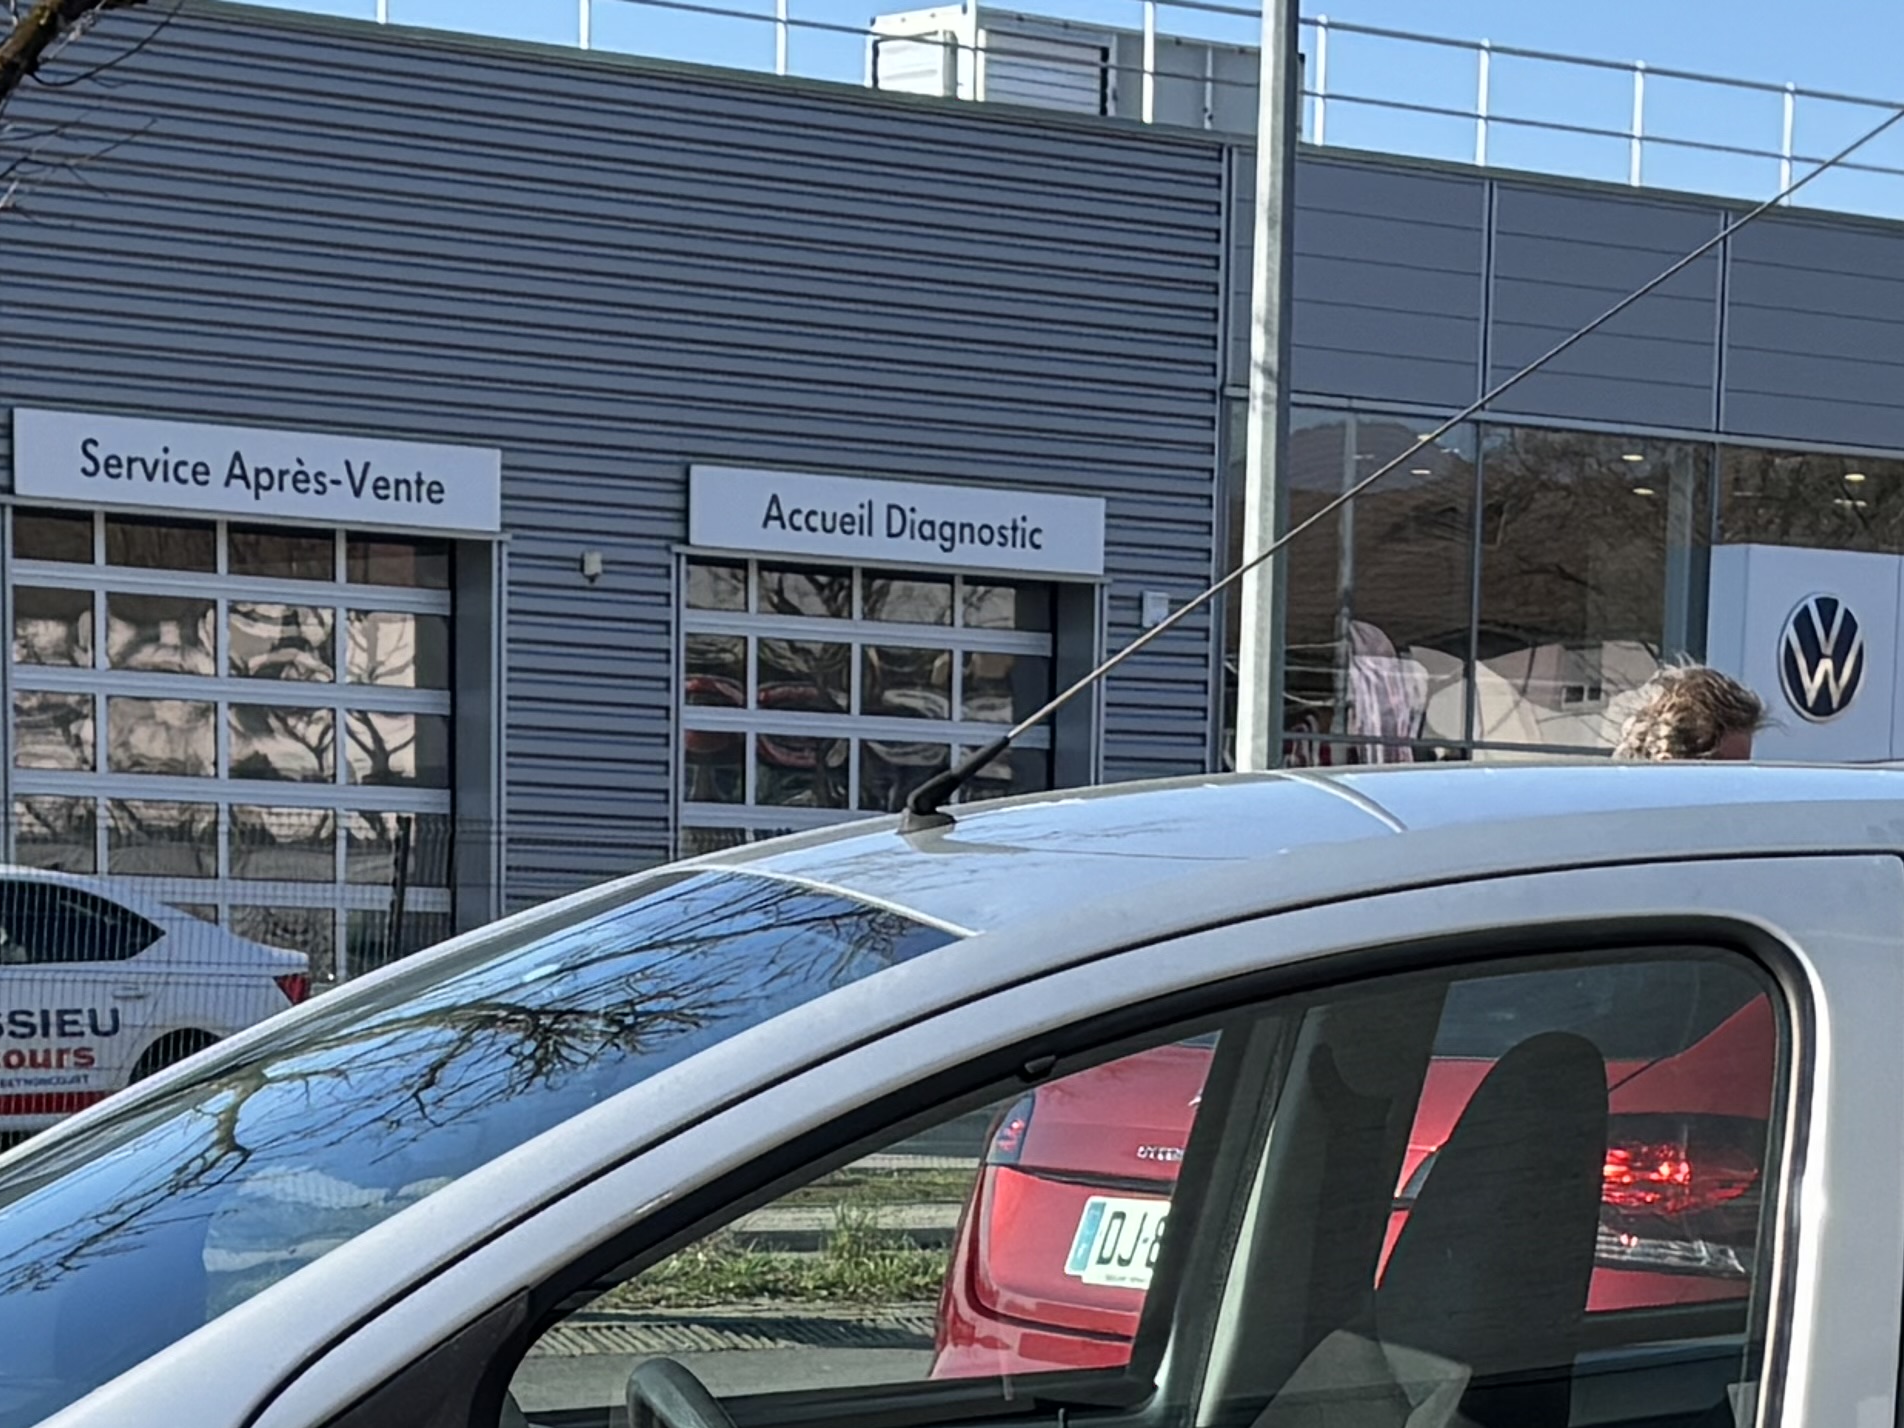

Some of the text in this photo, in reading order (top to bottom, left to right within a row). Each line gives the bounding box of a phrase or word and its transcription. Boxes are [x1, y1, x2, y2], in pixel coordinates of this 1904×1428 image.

[79, 437, 446, 505] Service Après-Vente
[761, 492, 1044, 554] Accueil Diagnostic
